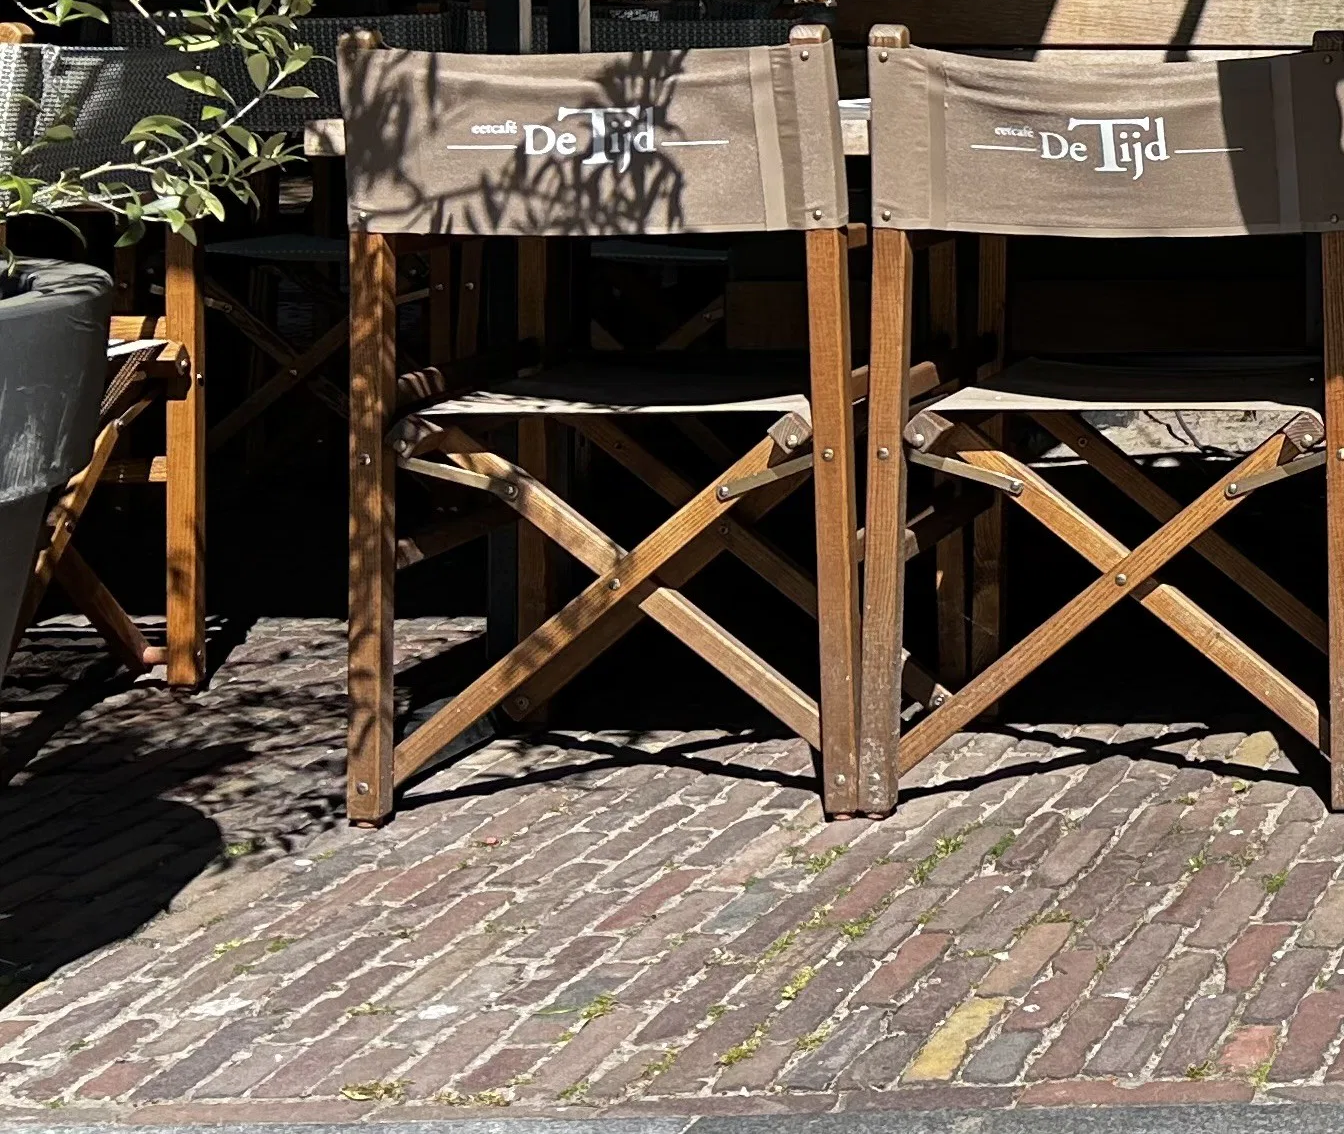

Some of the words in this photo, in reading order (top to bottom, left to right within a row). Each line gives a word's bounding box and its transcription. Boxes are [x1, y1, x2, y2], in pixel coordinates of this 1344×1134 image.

[523, 124, 577, 155] De
[557, 104, 657, 173] Tijd
[1039, 131, 1088, 161] De
[1067, 116, 1170, 180] Tijd
